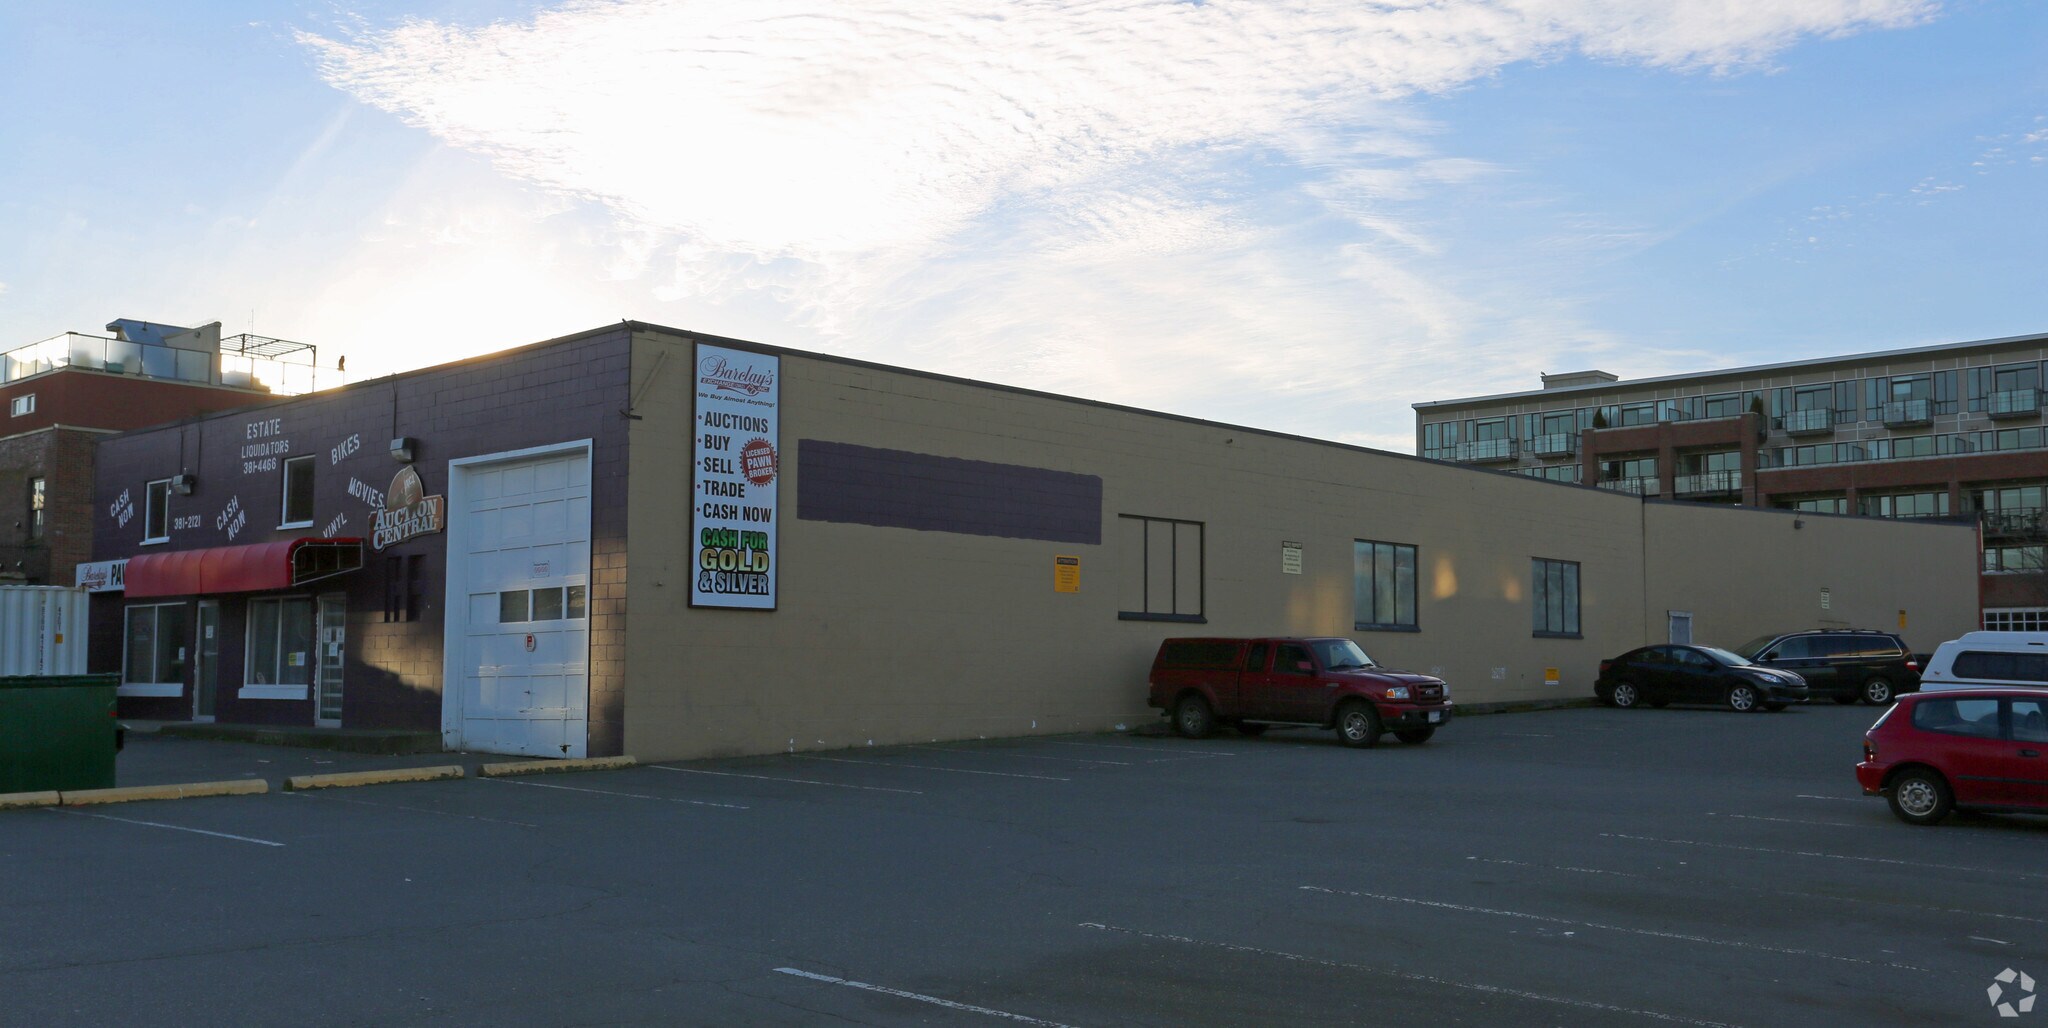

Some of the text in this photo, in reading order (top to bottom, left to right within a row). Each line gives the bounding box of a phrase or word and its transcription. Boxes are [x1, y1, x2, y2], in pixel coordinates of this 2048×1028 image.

[700, 355, 774, 387] Barclay's
[710, 393, 722, 401] Buy
[724, 395, 746, 403] Almost
[247, 419, 280, 439] ESTATE
[704, 411, 769, 433] AUCTIONS
[242, 440, 289, 458] LIQUIDATORS
[332, 434, 360, 465] BIKES
[704, 434, 731, 451] BUY
[745, 447, 770, 457] LICENSED
[243, 458, 277, 474] 381-4466
[703, 457, 734, 474] SELL
[747, 455, 772, 469] PAWN
[749, 467, 774, 478] BROKER
[348, 477, 385, 508] MOVIES
[703, 480, 745, 498] TRADE
[110, 488, 129, 517] CASH
[216, 495, 239, 531] CASH
[703, 502, 772, 523] CASH NOW
[118, 502, 134, 529] NOW
[174, 515, 200, 530] 381-2121
[227, 510, 246, 541] NOW
[323, 512, 348, 538] VINYL
[373, 515, 437, 550] CENTRAL
[741, 530, 768, 551] FOR
[700, 547, 769, 573] GOLD
[698, 569, 769, 595] & SILVER
